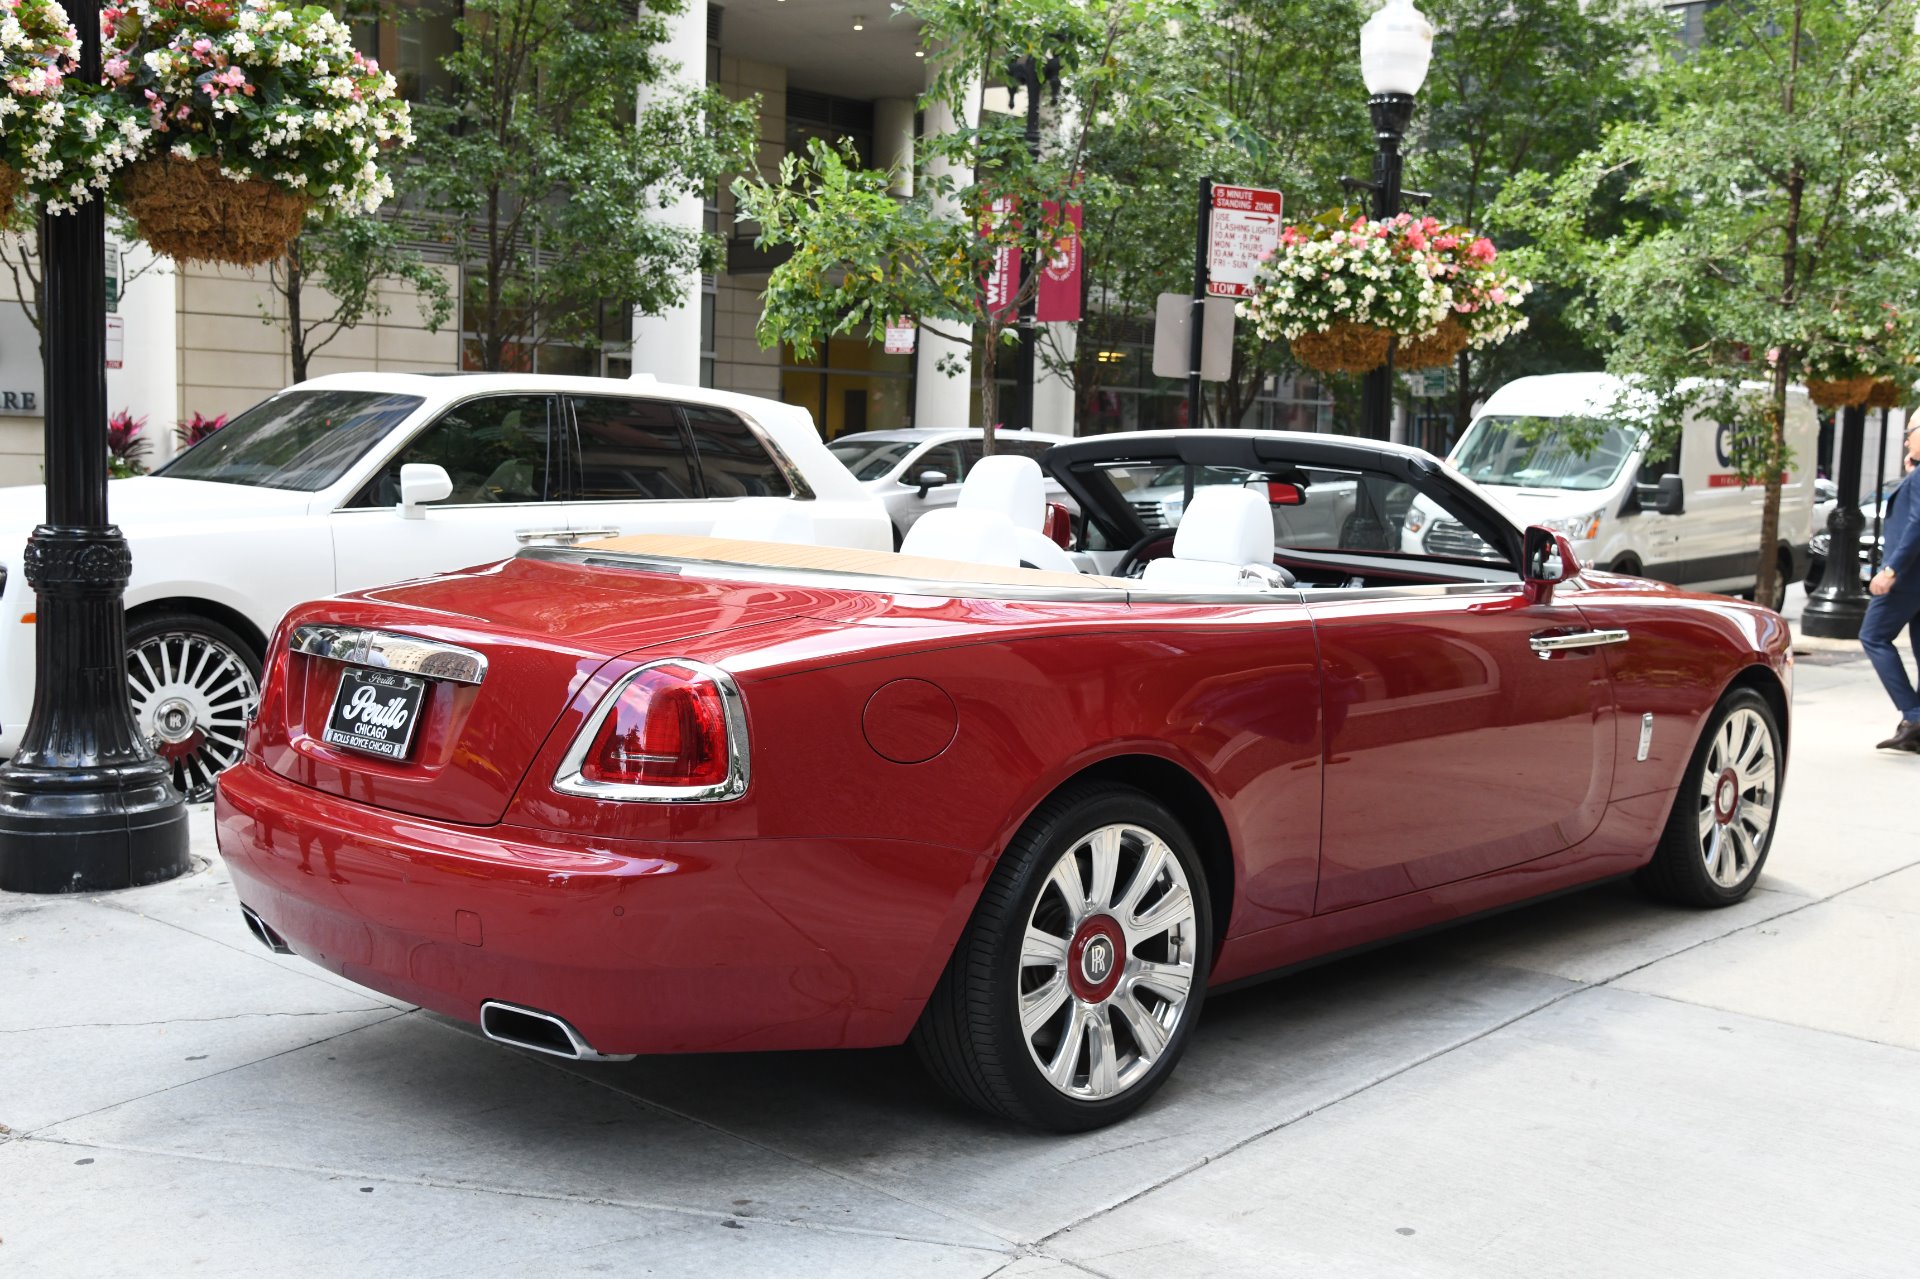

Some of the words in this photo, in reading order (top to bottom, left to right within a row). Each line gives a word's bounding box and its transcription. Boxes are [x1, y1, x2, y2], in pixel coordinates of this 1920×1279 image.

[1217, 189, 1225, 197] 15
[1227, 190, 1253, 200] MINUTE
[1217, 198, 1252, 210] STANDING
[1255, 202, 1275, 212] ZONE
[1215, 213, 1230, 221] USE
[1215, 222, 1250, 233] FLASHING
[1252, 226, 1276, 236] LIGHTS
[1215, 231, 1223, 239] 10
[1242, 233, 1247, 241] 8
[1214, 240, 1231, 248] MON
[1239, 242, 1263, 252] THURS
[1214, 249, 1222, 257] 10
[1222, 250, 1234, 258] AM
[1241, 252, 1246, 260] 6
[1213, 258, 1225, 266] FRI
[1232, 260, 1248, 269] SUN
[1000, 274, 1009, 305] WATER
[1213, 282, 1236, 294] TOW
[0, 391, 37, 410] RE
[369, 673, 396, 686] Perillo
[342, 685, 409, 730] Perillo
[354, 722, 388, 740] CHICAGO
[332, 732, 350, 745] ROLLS
[349, 735, 369, 749] ROYCE
[368, 740, 394, 754] CHICAGO
